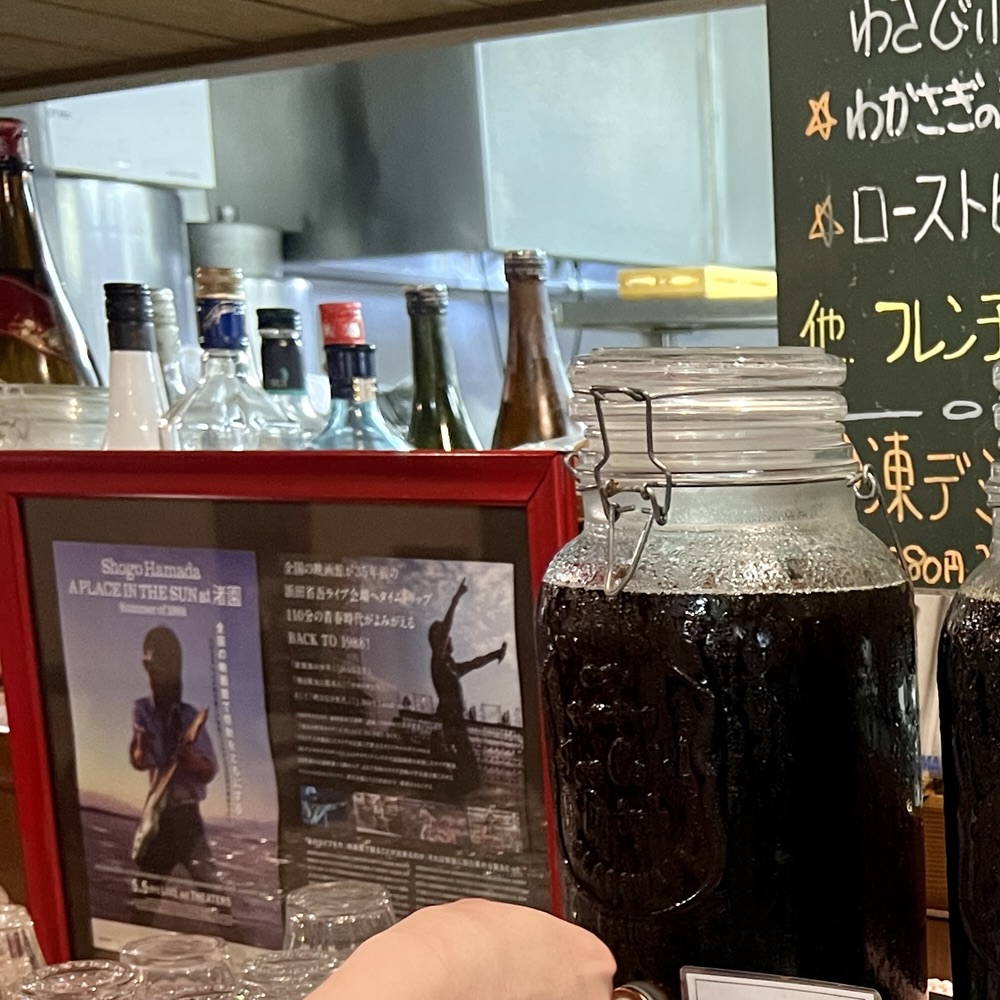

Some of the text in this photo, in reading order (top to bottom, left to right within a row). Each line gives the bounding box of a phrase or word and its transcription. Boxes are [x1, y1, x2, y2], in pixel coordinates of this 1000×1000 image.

[101, 558, 202, 581] Shogo Hamada
[79, 580, 121, 598] PLACE
[123, 582, 138, 599] IN
[138, 584, 168, 601] THE
[169, 586, 198, 603] SUN
[288, 631, 318, 646] BACK
[321, 633, 338, 647] TO
